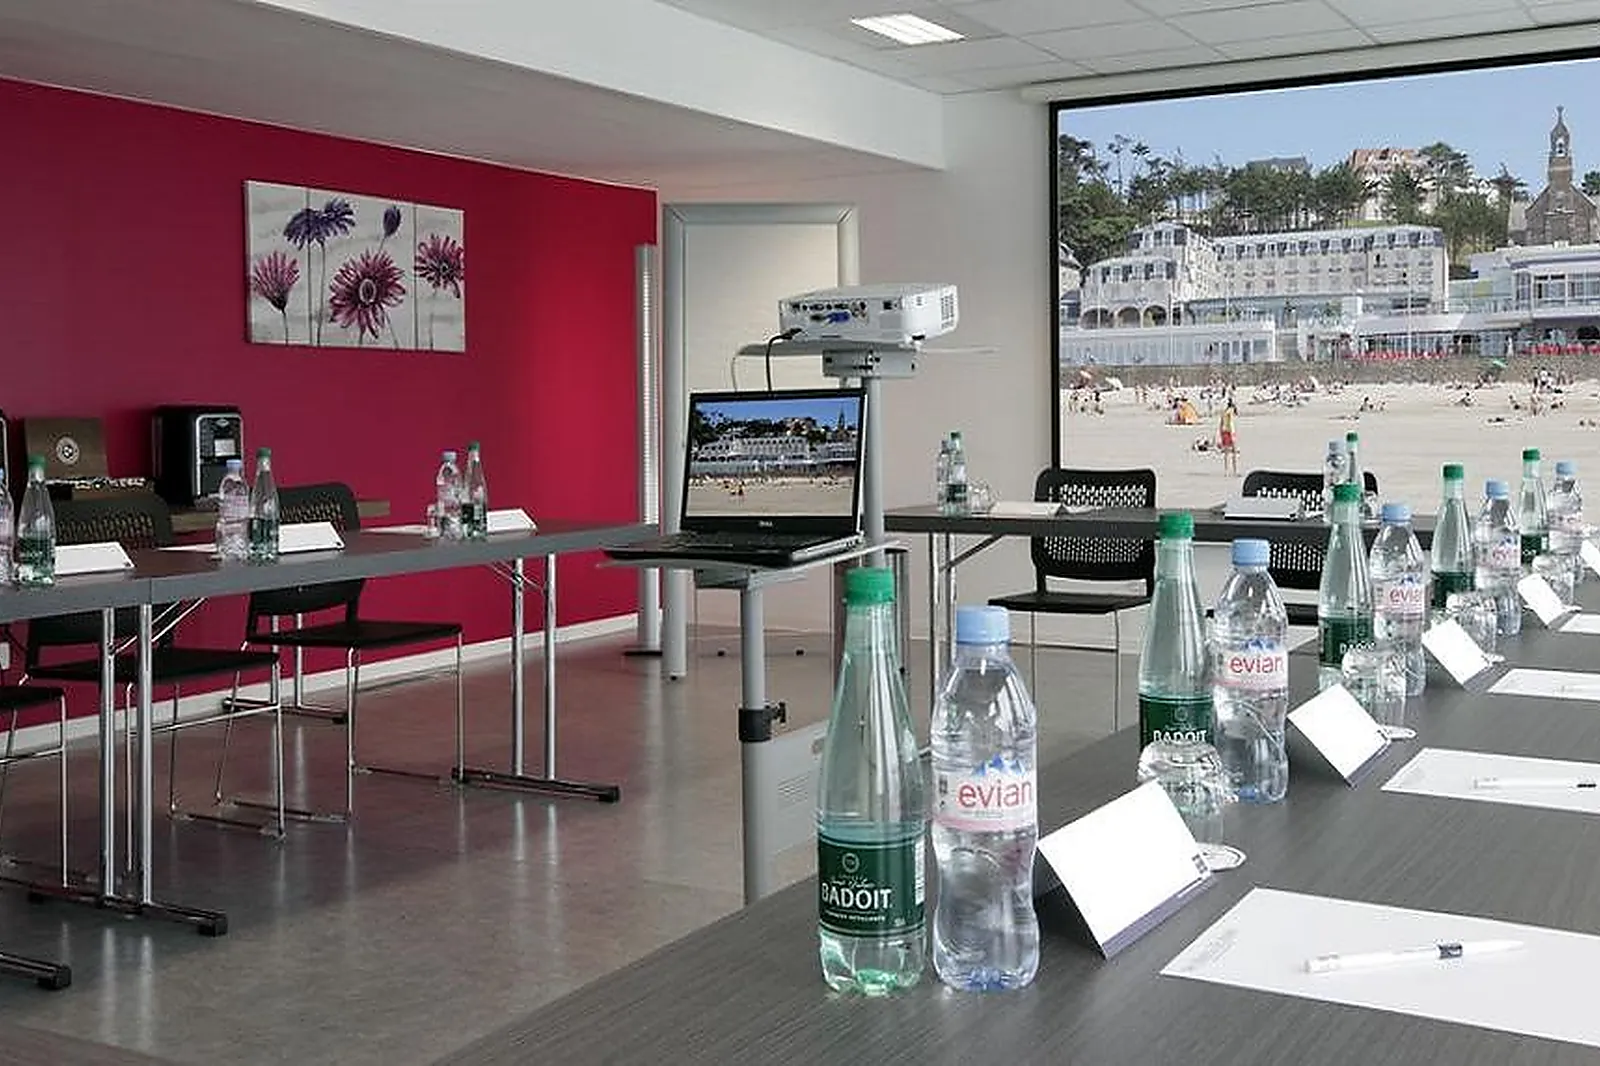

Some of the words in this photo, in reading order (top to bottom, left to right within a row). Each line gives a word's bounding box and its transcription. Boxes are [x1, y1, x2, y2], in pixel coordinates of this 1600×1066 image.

[1230, 655, 1284, 674] evian
[959, 779, 1032, 808] evian
[822, 882, 892, 909] BADOIT
